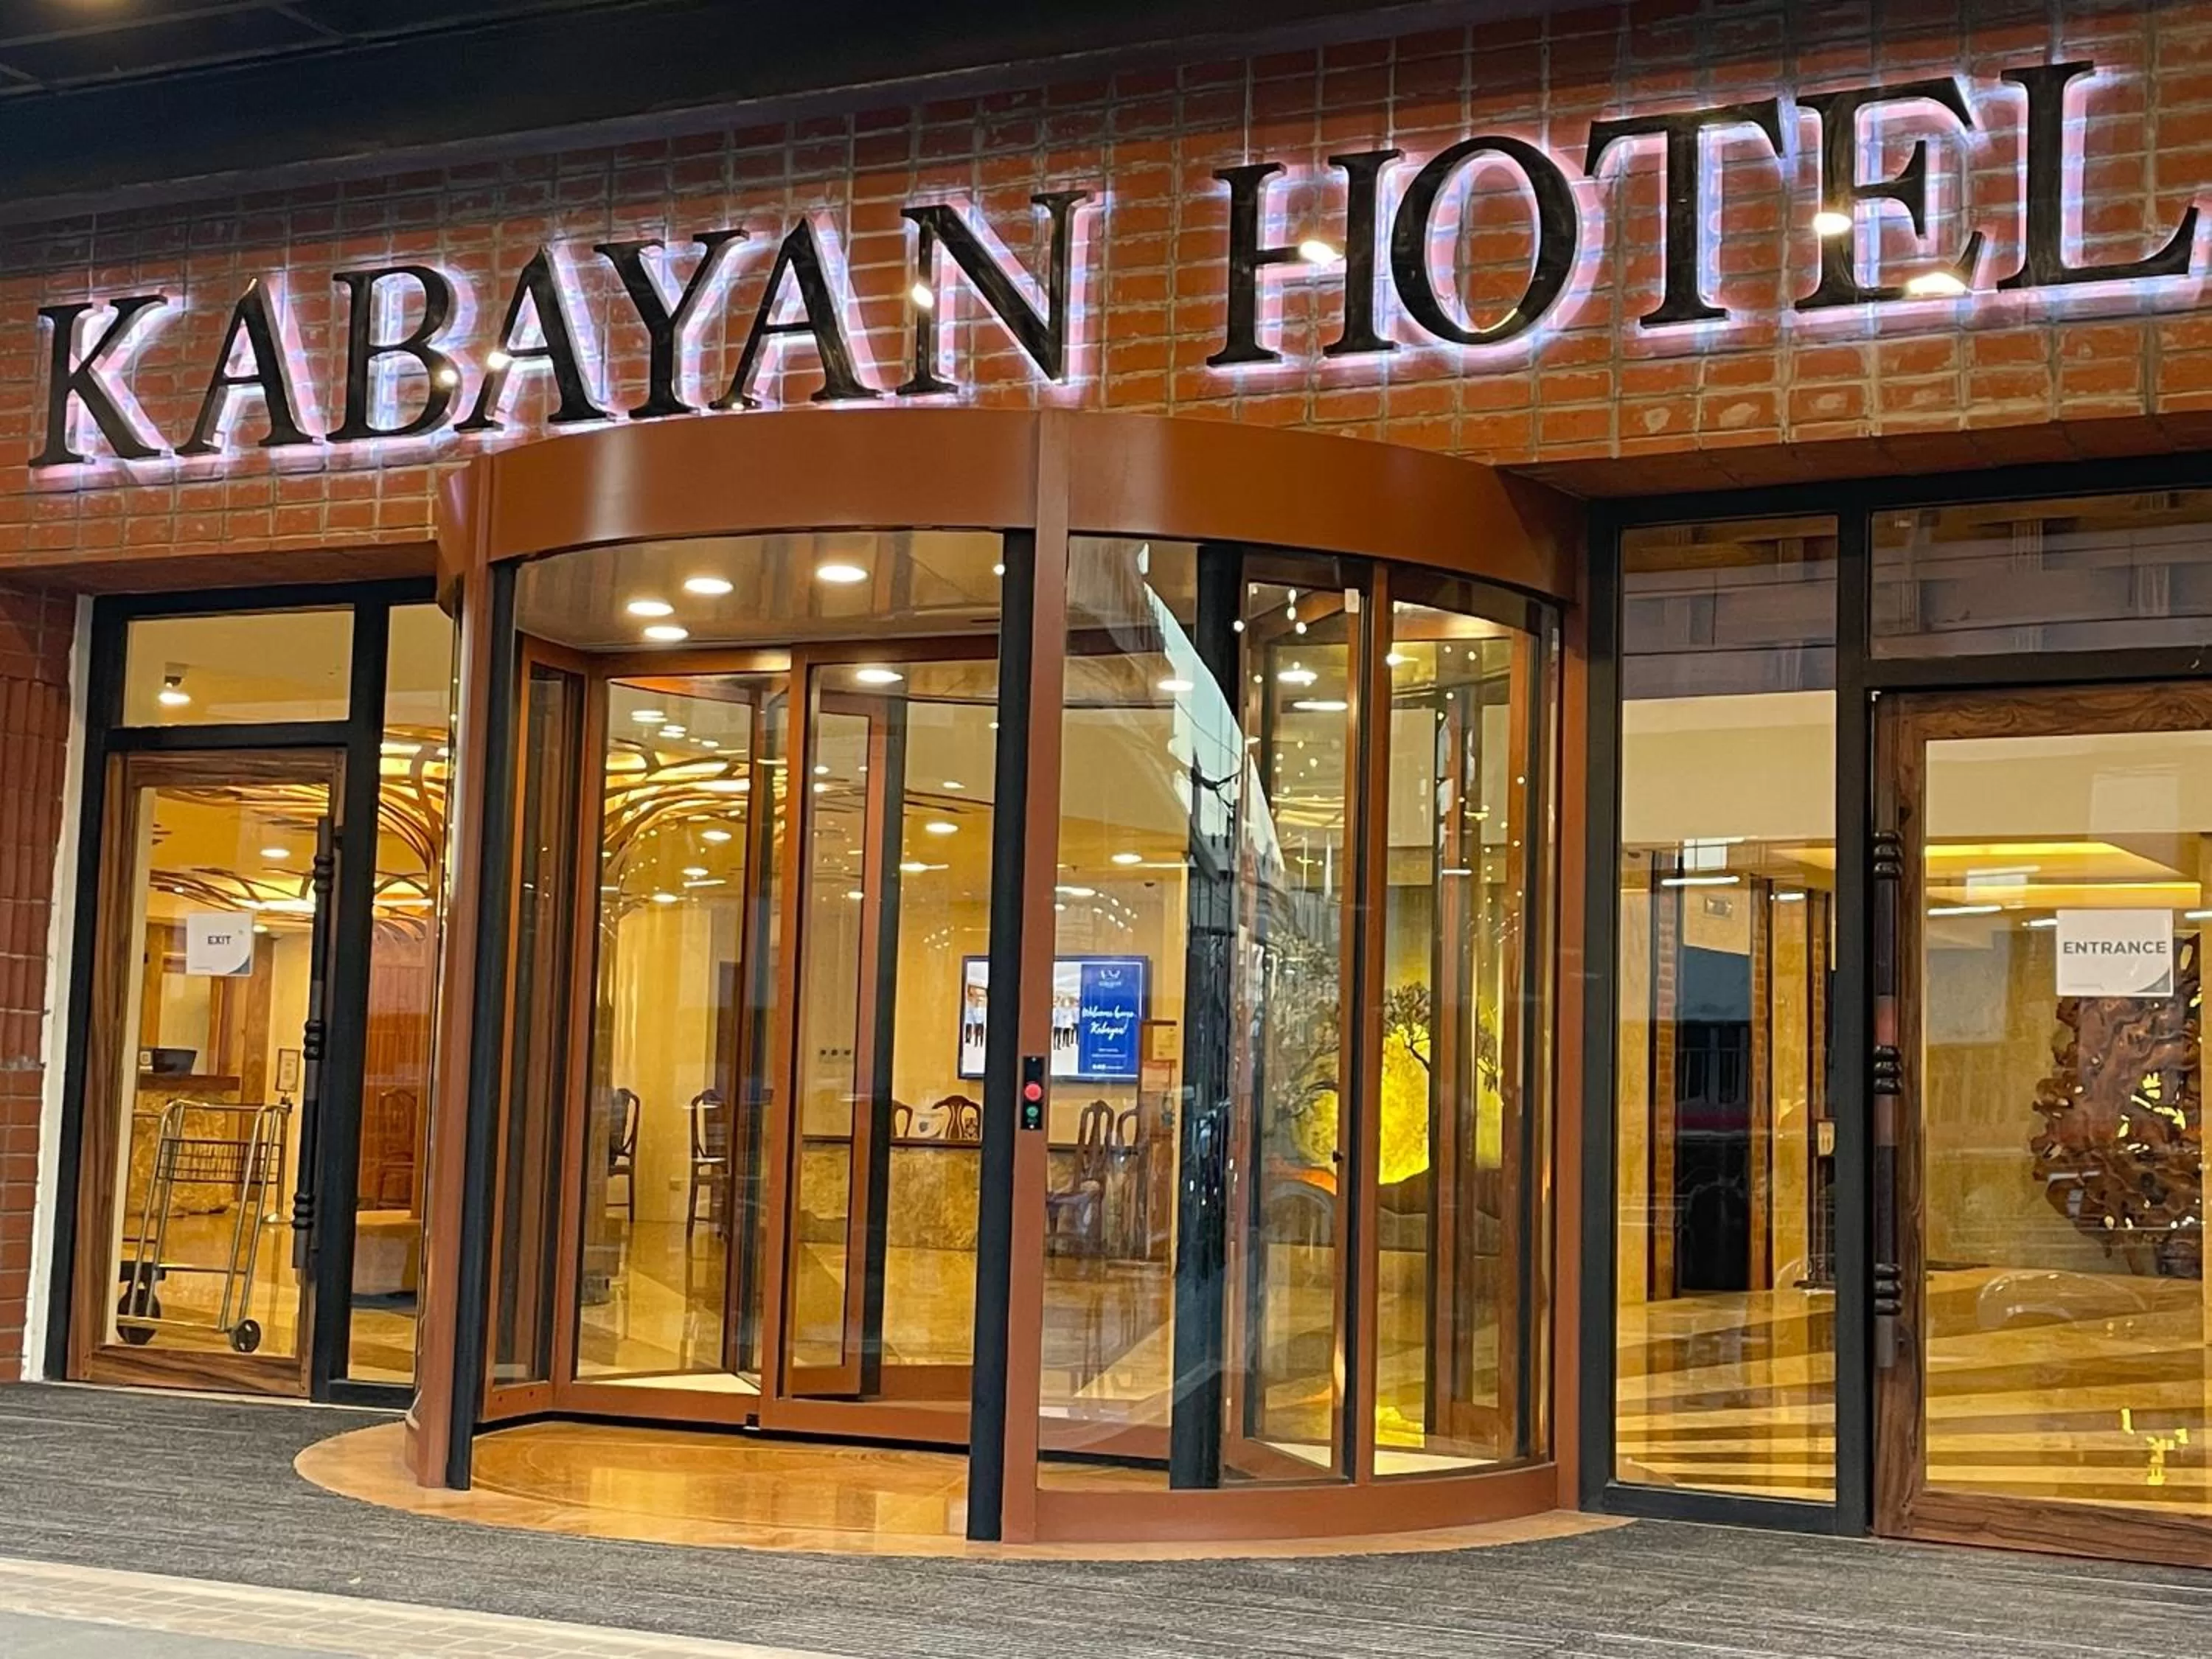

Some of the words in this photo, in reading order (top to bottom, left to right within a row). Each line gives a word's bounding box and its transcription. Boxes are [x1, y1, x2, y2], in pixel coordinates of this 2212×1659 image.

[29, 190, 1095, 468] KABAYAN
[1206, 60, 2199, 367] HOTEL
[207, 936, 232, 945] EXIT
[2063, 941, 2167, 954] ENTRANCE
